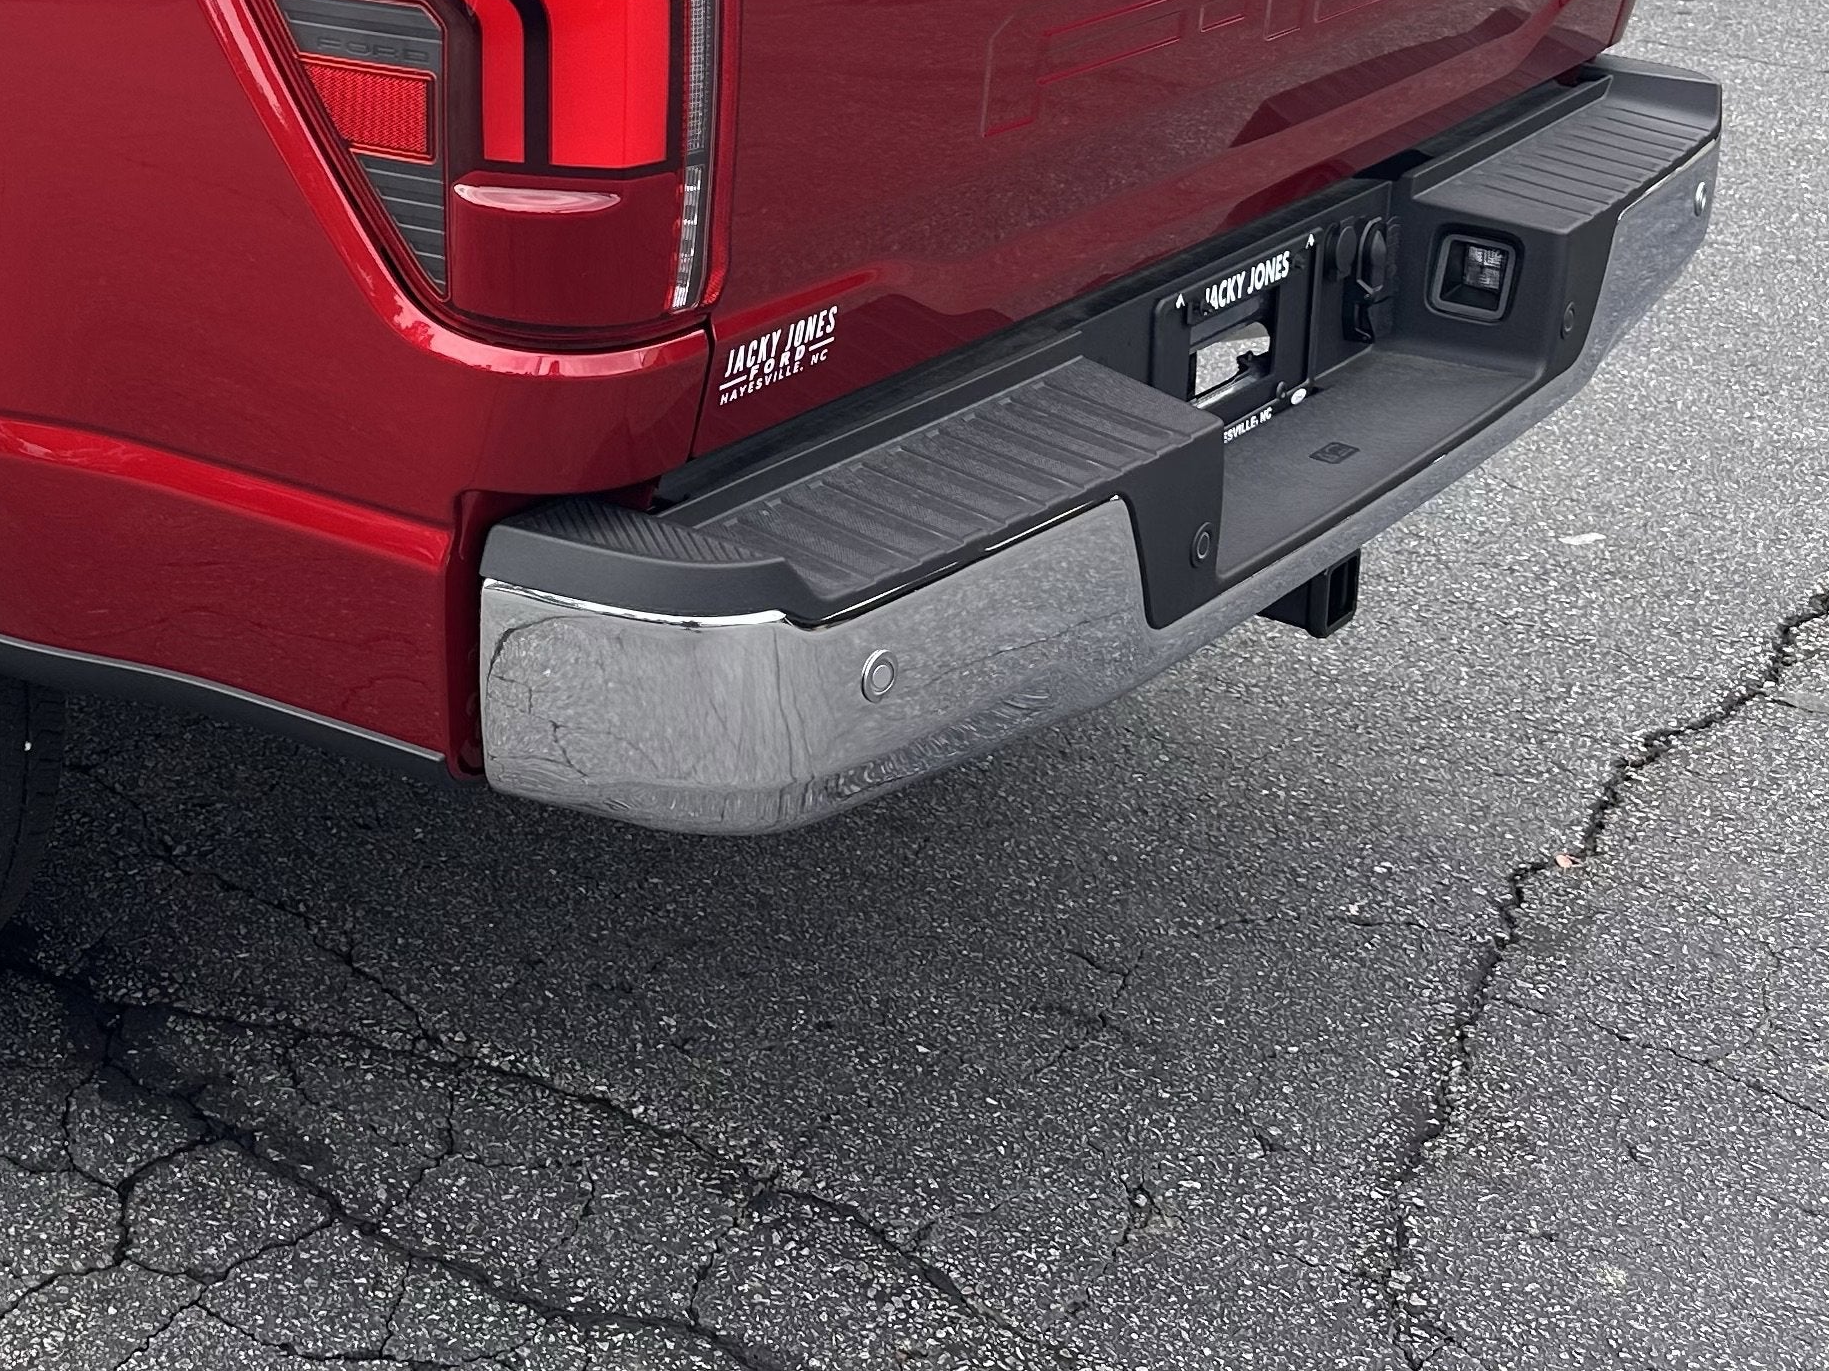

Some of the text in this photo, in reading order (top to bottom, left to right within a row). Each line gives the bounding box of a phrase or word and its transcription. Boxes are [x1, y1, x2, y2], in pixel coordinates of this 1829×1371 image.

[317, 37, 429, 65] FORD
[1247, 250, 1290, 295] JONES
[724, 305, 838, 378] JACKY JONES
[810, 348, 829, 366] NC
[748, 344, 806, 381] FORD
[1259, 406, 1273, 424] NC
